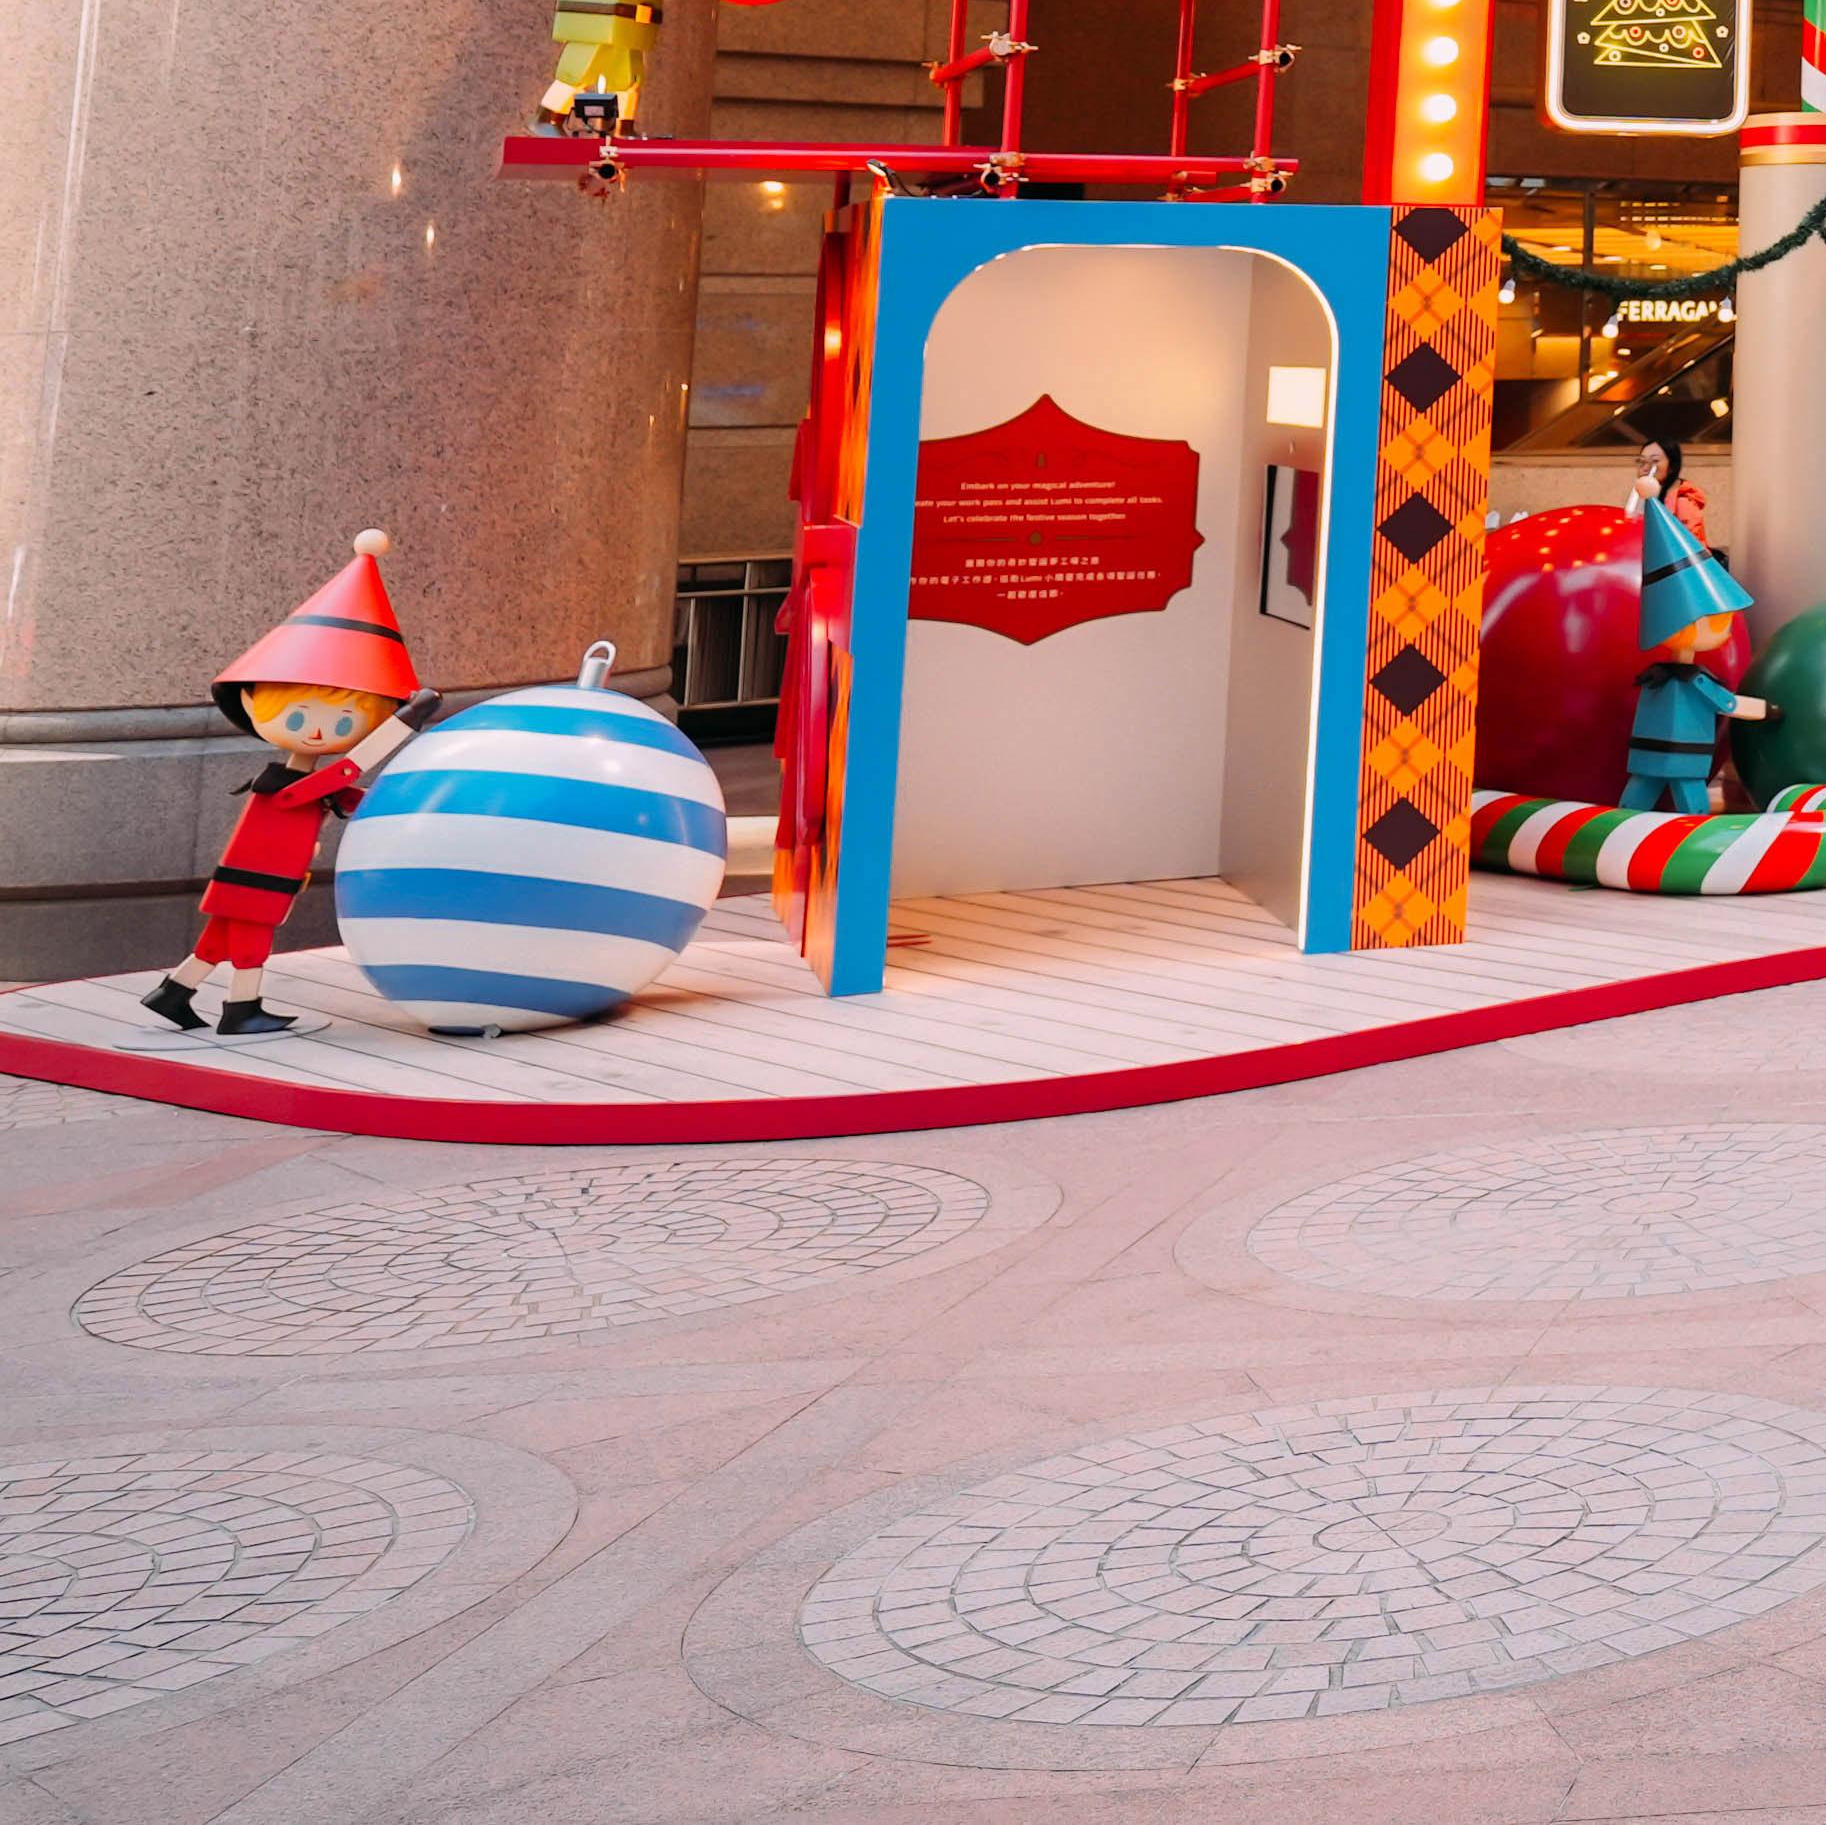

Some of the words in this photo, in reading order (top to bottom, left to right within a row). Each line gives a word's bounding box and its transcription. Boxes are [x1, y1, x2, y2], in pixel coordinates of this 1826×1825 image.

[1617, 300, 1738, 323] FERRAGA
[1010, 483, 1031, 492] your
[1005, 498, 1023, 506] and
